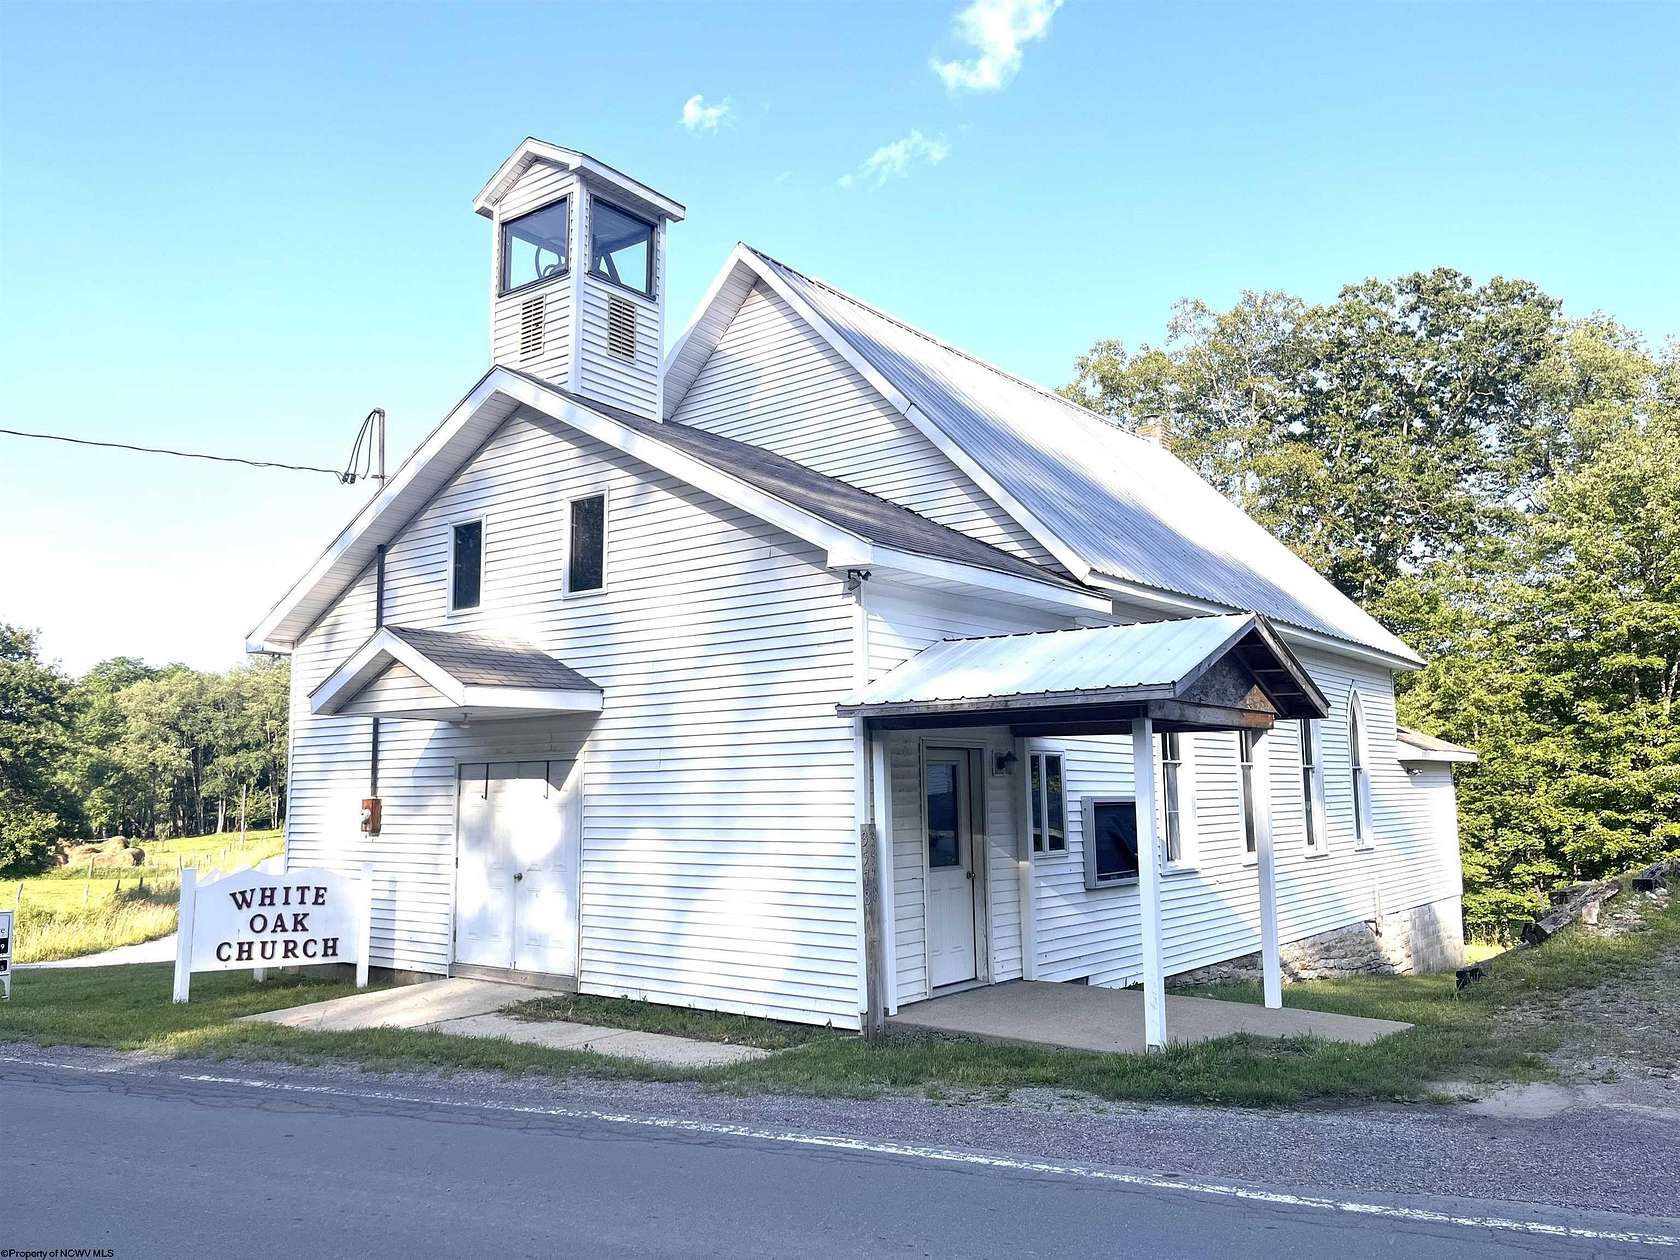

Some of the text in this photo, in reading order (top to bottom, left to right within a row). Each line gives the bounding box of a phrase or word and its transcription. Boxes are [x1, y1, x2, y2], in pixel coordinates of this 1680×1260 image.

[229, 886, 328, 911] WHITE
[249, 912, 310, 934] OAK
[216, 937, 340, 962] CHURCH
